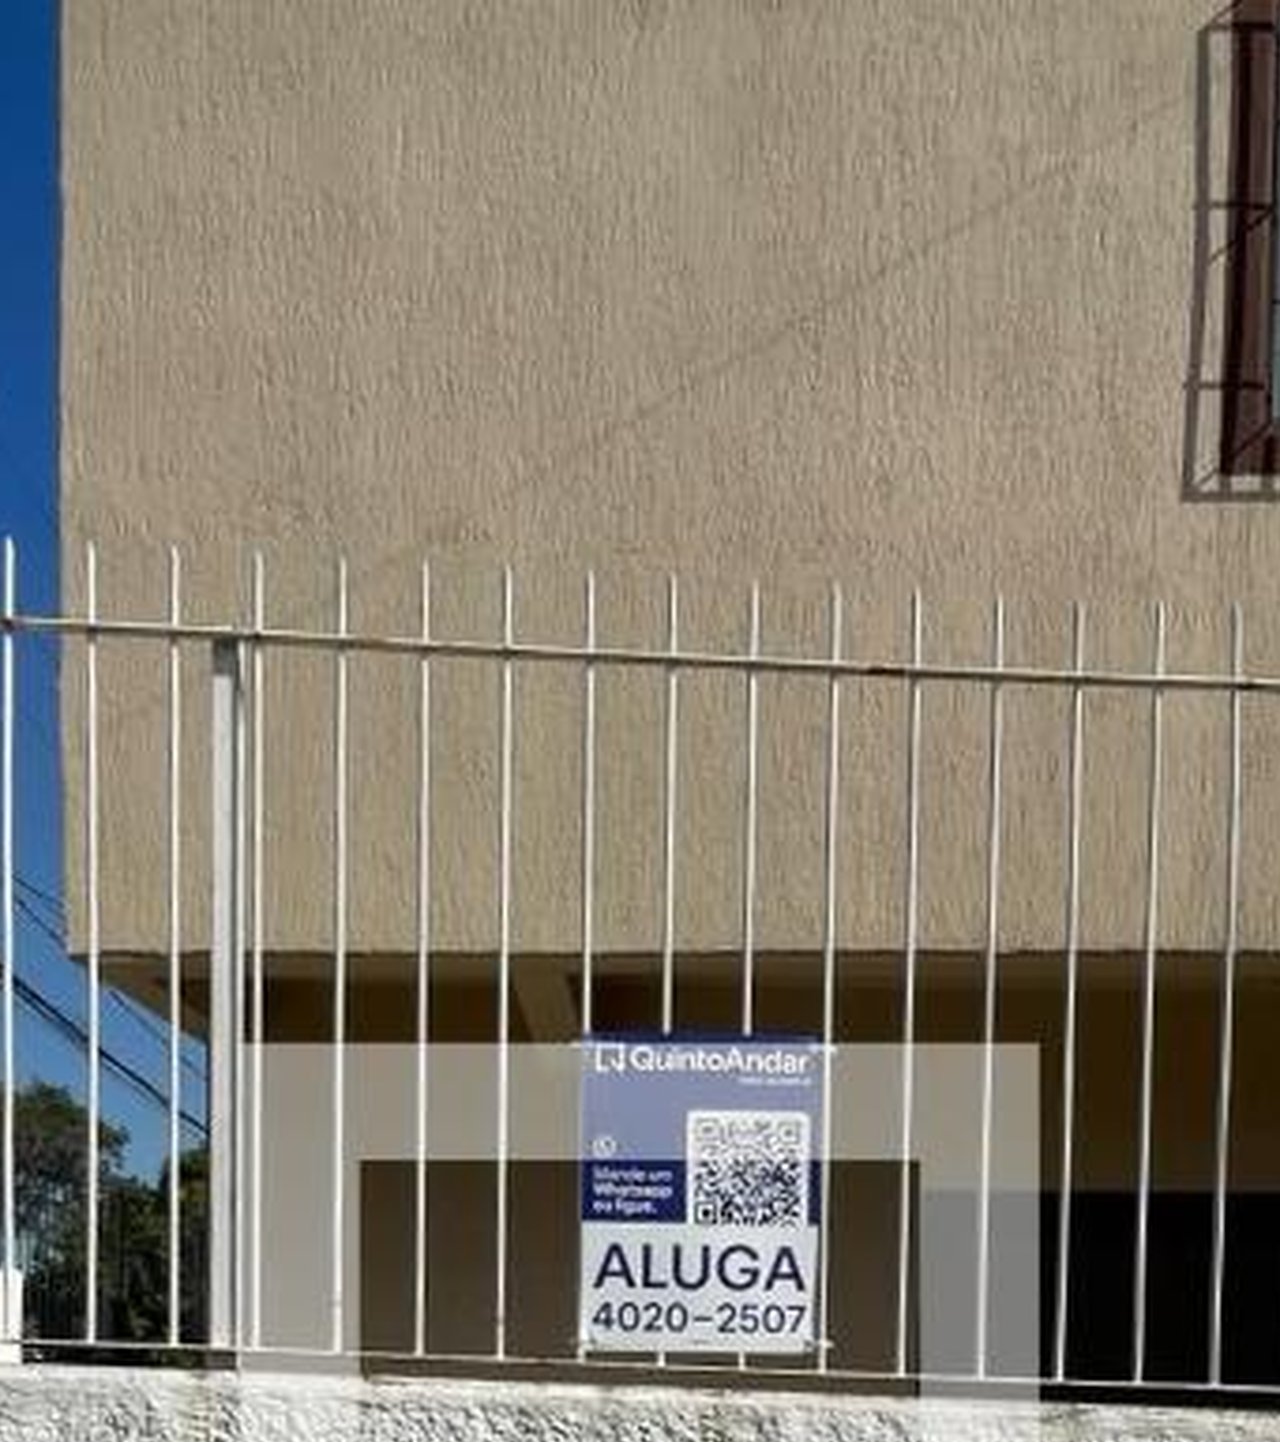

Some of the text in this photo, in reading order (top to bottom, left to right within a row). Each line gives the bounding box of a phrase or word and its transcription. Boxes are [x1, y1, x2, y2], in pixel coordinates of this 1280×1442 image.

[630, 1046, 809, 1074] QuintoAndar
[593, 1243, 806, 1291] ALUGA
[592, 1302, 807, 1334] 4020-2507
